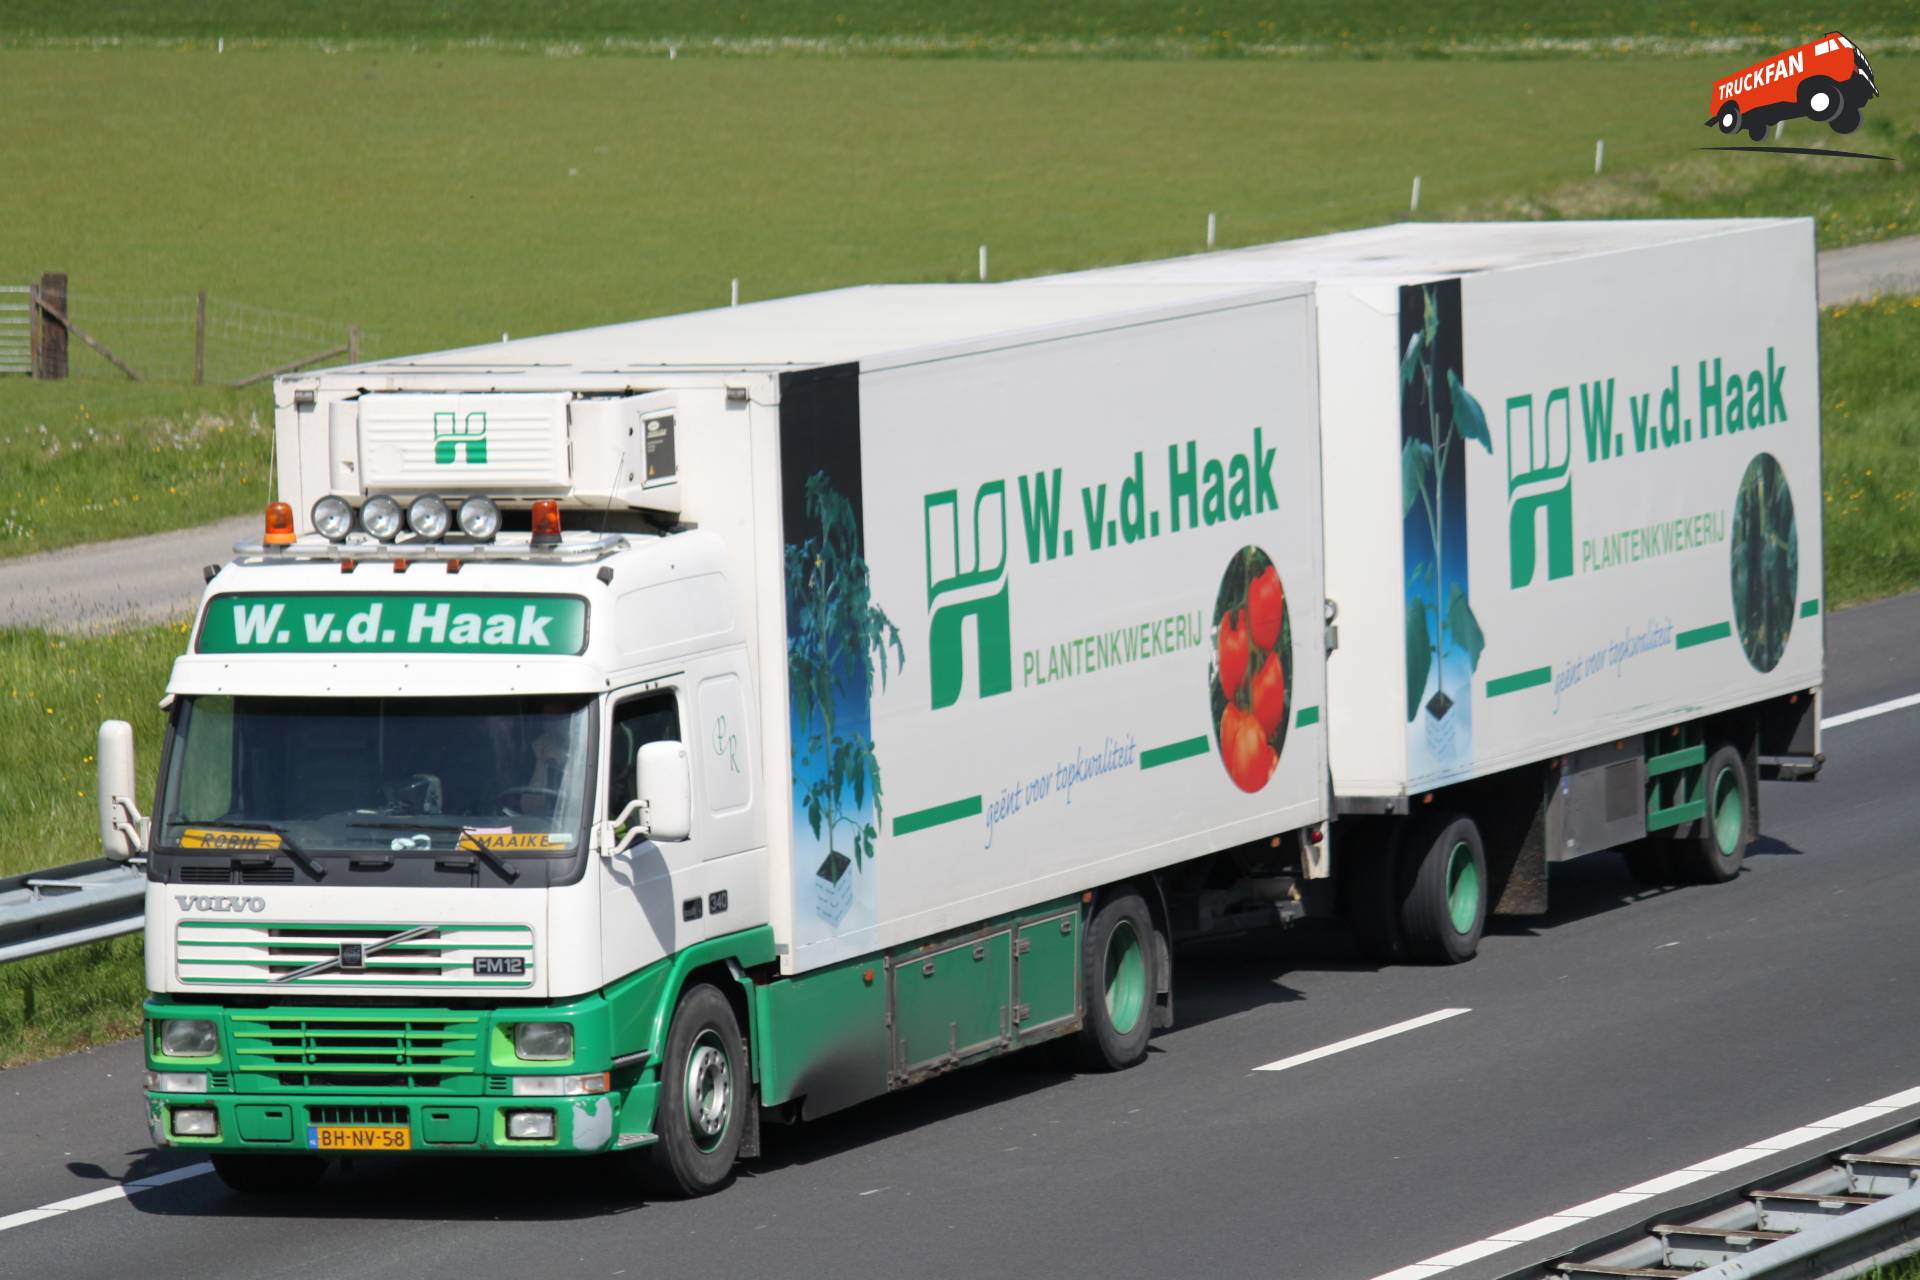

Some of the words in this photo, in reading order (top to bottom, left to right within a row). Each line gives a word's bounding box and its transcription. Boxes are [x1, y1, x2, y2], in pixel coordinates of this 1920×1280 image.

[1580, 377, 1623, 463] W.
[1630, 365, 1692, 453] v.d.
[1699, 346, 1788, 440] Haak
[1018, 467, 1074, 565] W.
[1082, 451, 1160, 551] v.d.
[1168, 426, 1279, 534] Haak
[1582, 510, 1726, 572] PLANTENKWEKERIJ
[233, 603, 290, 645] W.
[304, 602, 396, 645] v.d.
[407, 602, 553, 646] Haak
[1023, 609, 1202, 688] PLANTENKWEKERIJ
[985, 781, 1023, 849] geënt
[1025, 772, 1053, 806] voor
[1056, 732, 1136, 805] topkwaliteit
[200, 833, 260, 849] ROBIN
[478, 835, 550, 848] MAAIKE
[174, 895, 266, 913] VOLVO
[475, 958, 522, 973] FM12
[322, 1130, 405, 1147] BH-NV-58
